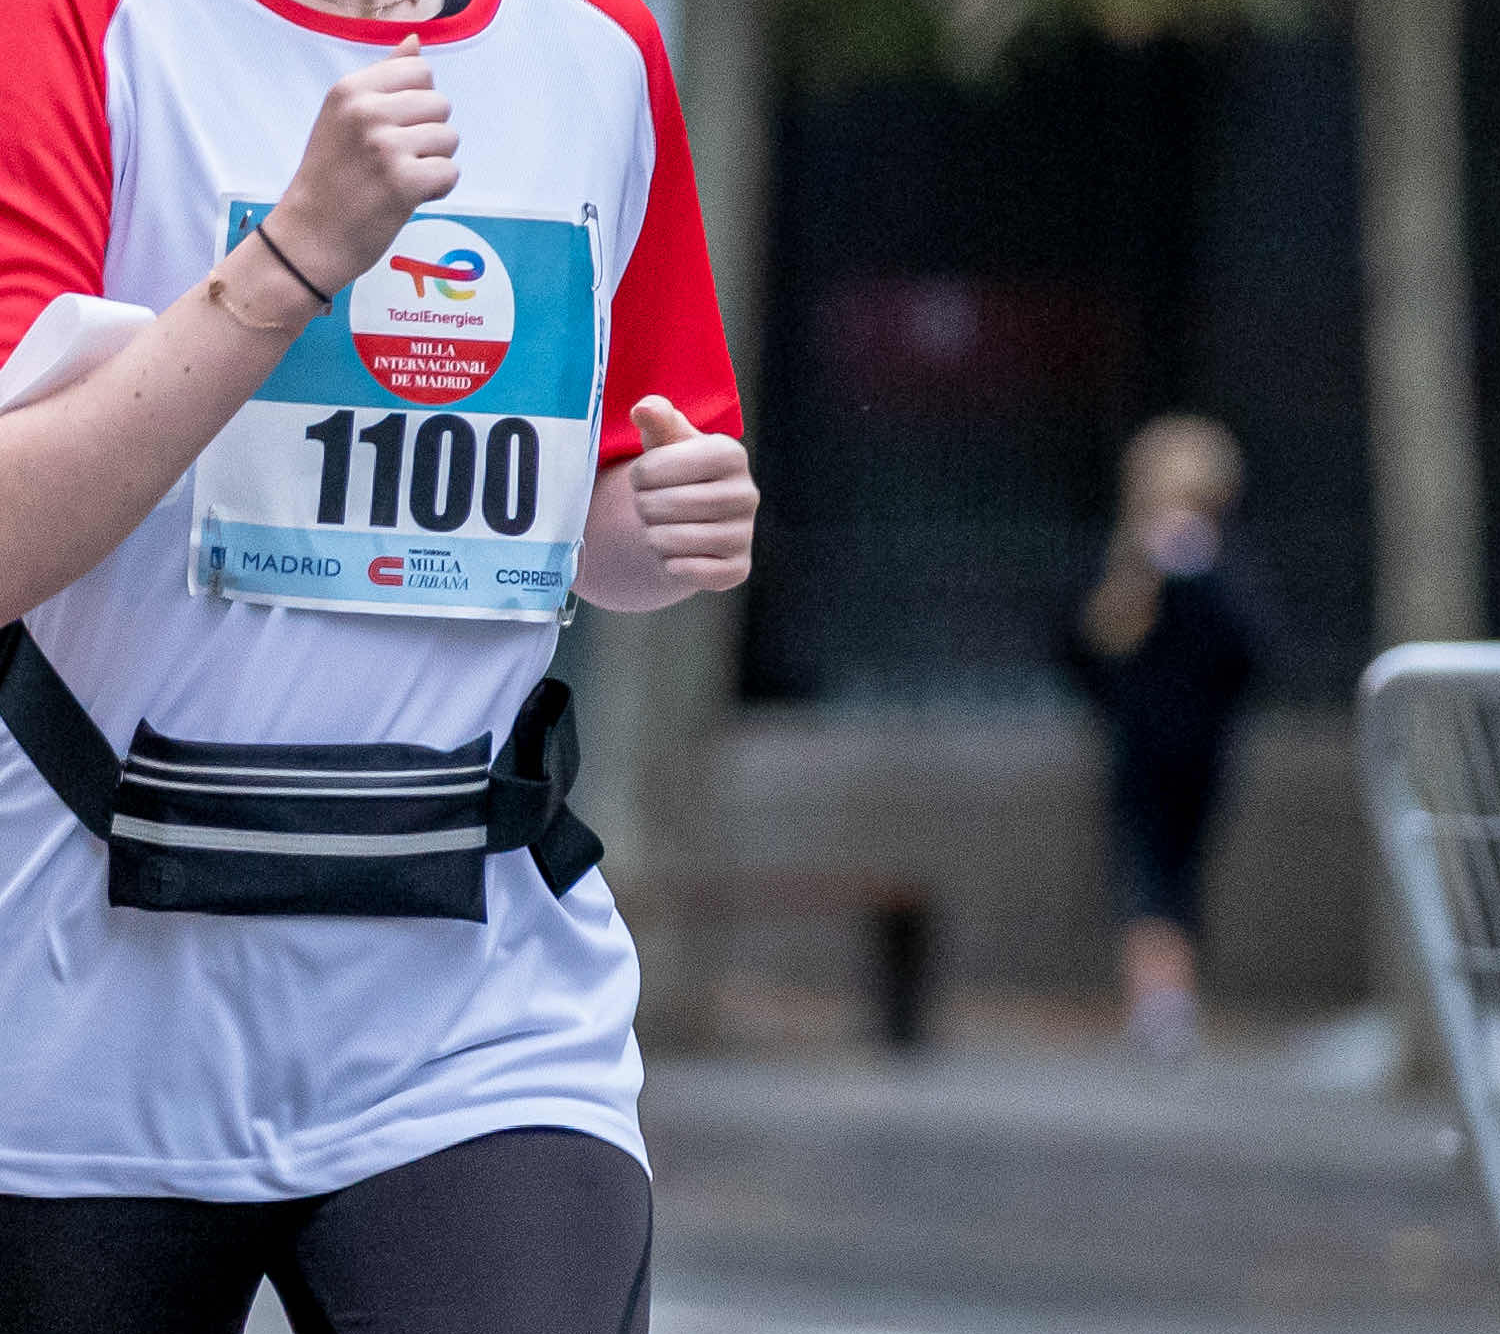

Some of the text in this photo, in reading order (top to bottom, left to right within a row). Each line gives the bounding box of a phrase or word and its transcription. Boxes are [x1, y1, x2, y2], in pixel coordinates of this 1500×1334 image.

[387, 308, 484, 327] TotalEnergies
[410, 342, 456, 356] MILLA
[391, 373, 472, 389] DE MADRID
[305, 410, 540, 536] 1100
[242, 551, 341, 576] MADRID
[409, 558, 461, 573] MILLA
[408, 575, 469, 590] URBANA
